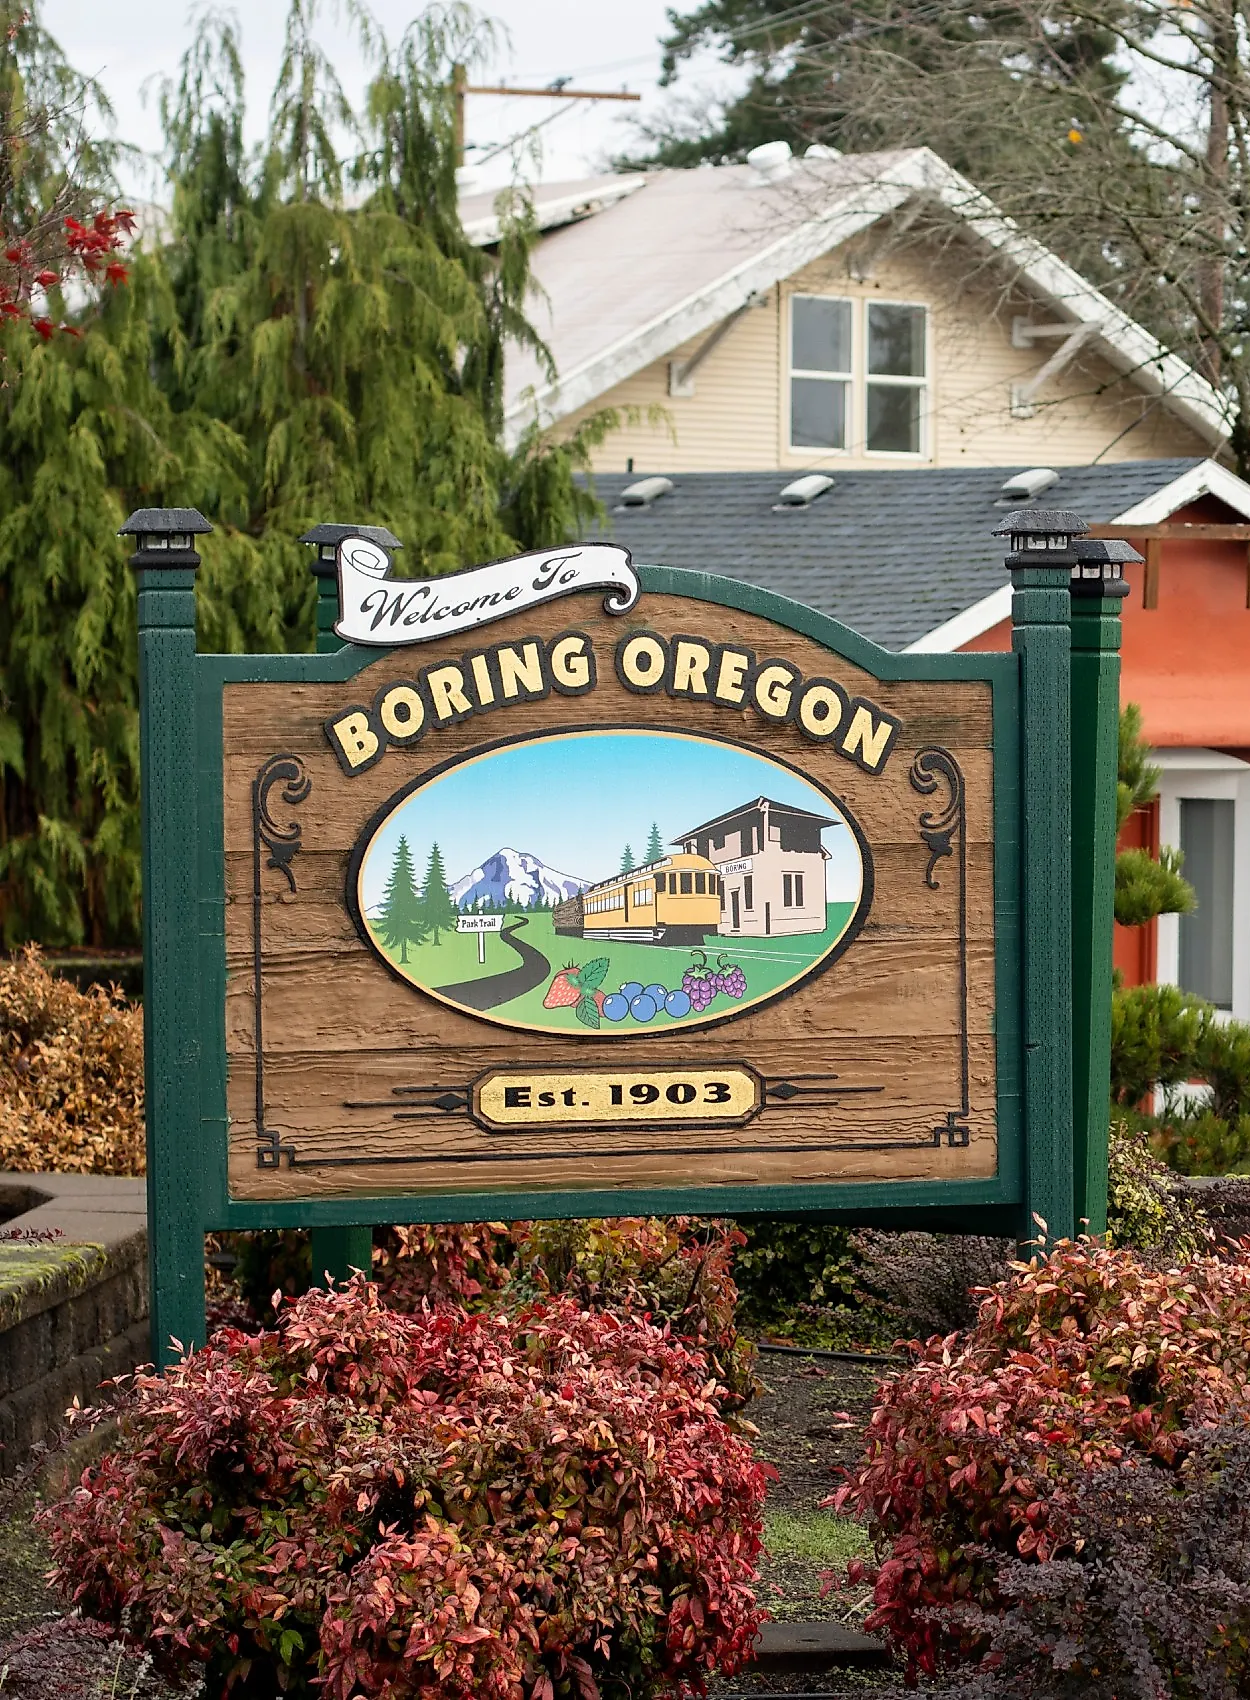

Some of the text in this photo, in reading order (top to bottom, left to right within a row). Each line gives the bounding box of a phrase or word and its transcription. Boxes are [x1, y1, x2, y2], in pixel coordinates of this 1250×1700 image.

[360, 552, 582, 632] Welcome To
[332, 636, 893, 769] BORING OREGON
[462, 918, 496, 928] Park Trail
[504, 1082, 732, 1108] Est. 1903
